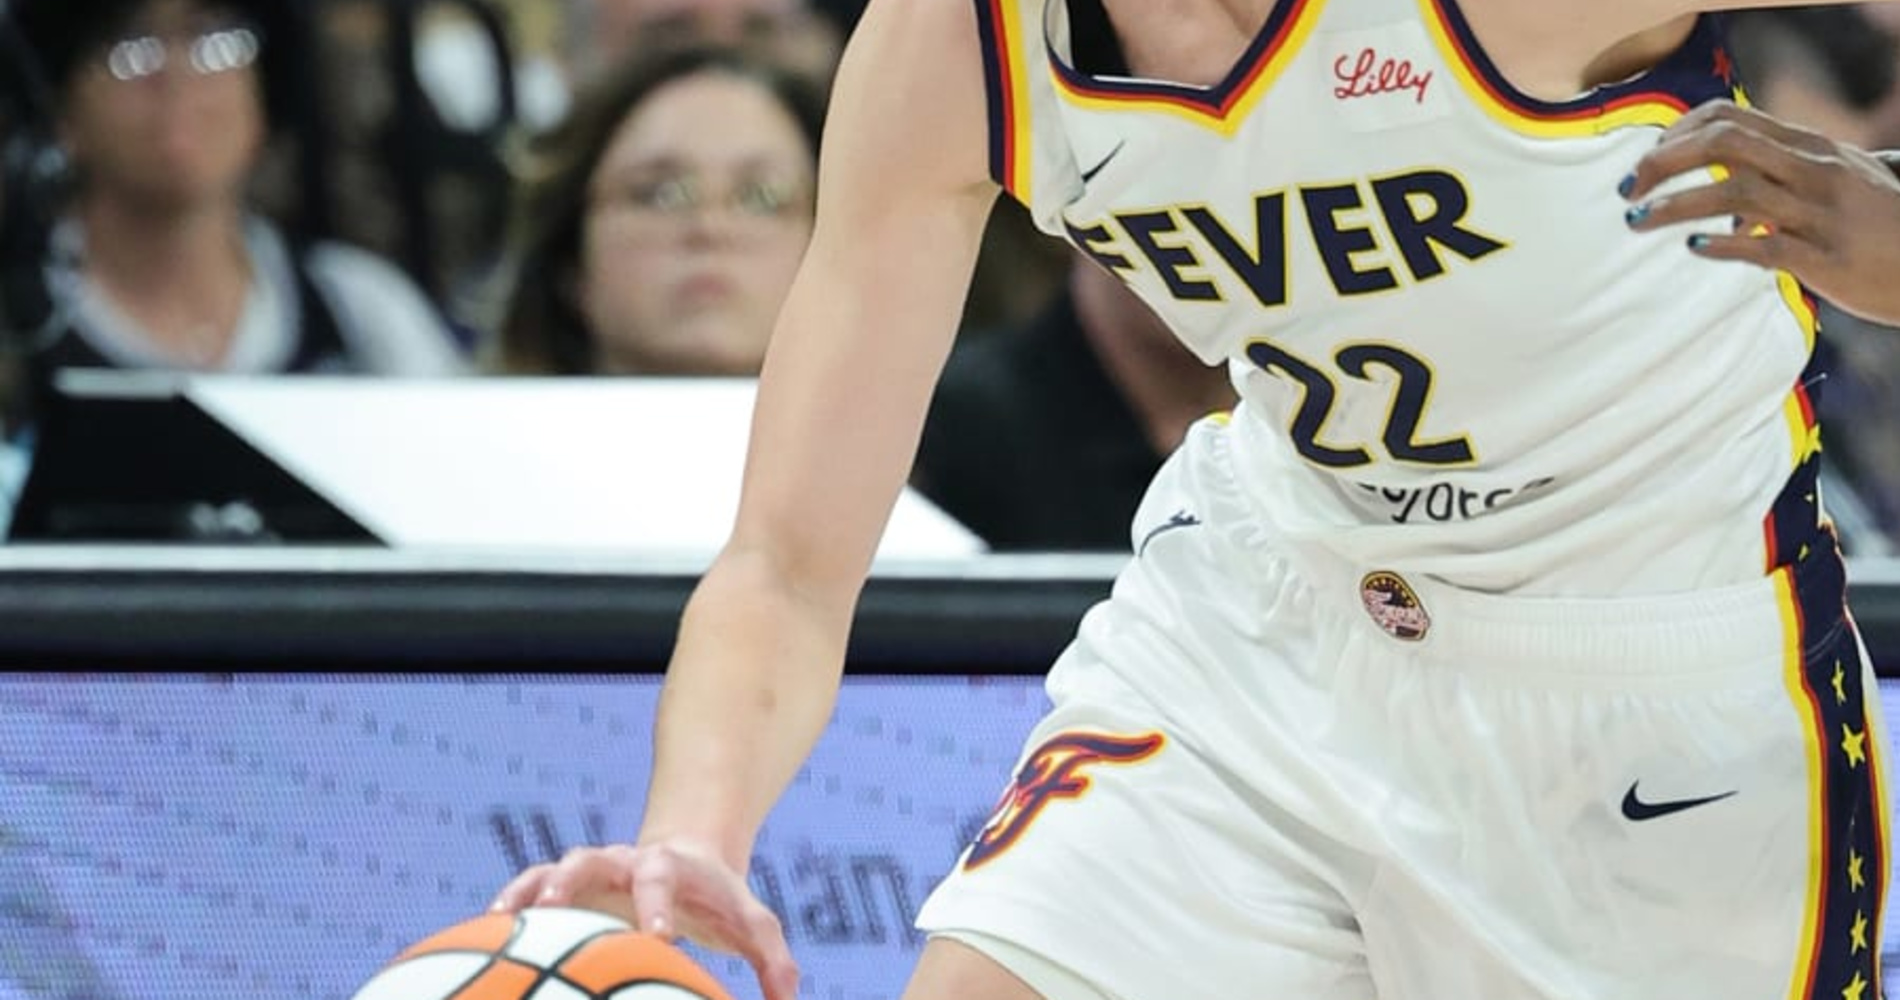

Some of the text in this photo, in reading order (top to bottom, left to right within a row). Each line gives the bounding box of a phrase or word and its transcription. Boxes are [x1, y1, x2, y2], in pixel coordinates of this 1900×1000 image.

[1334, 47, 1432, 104] Lilly
[1063, 169, 1513, 308] FEVER
[1244, 339, 1476, 468] 22
